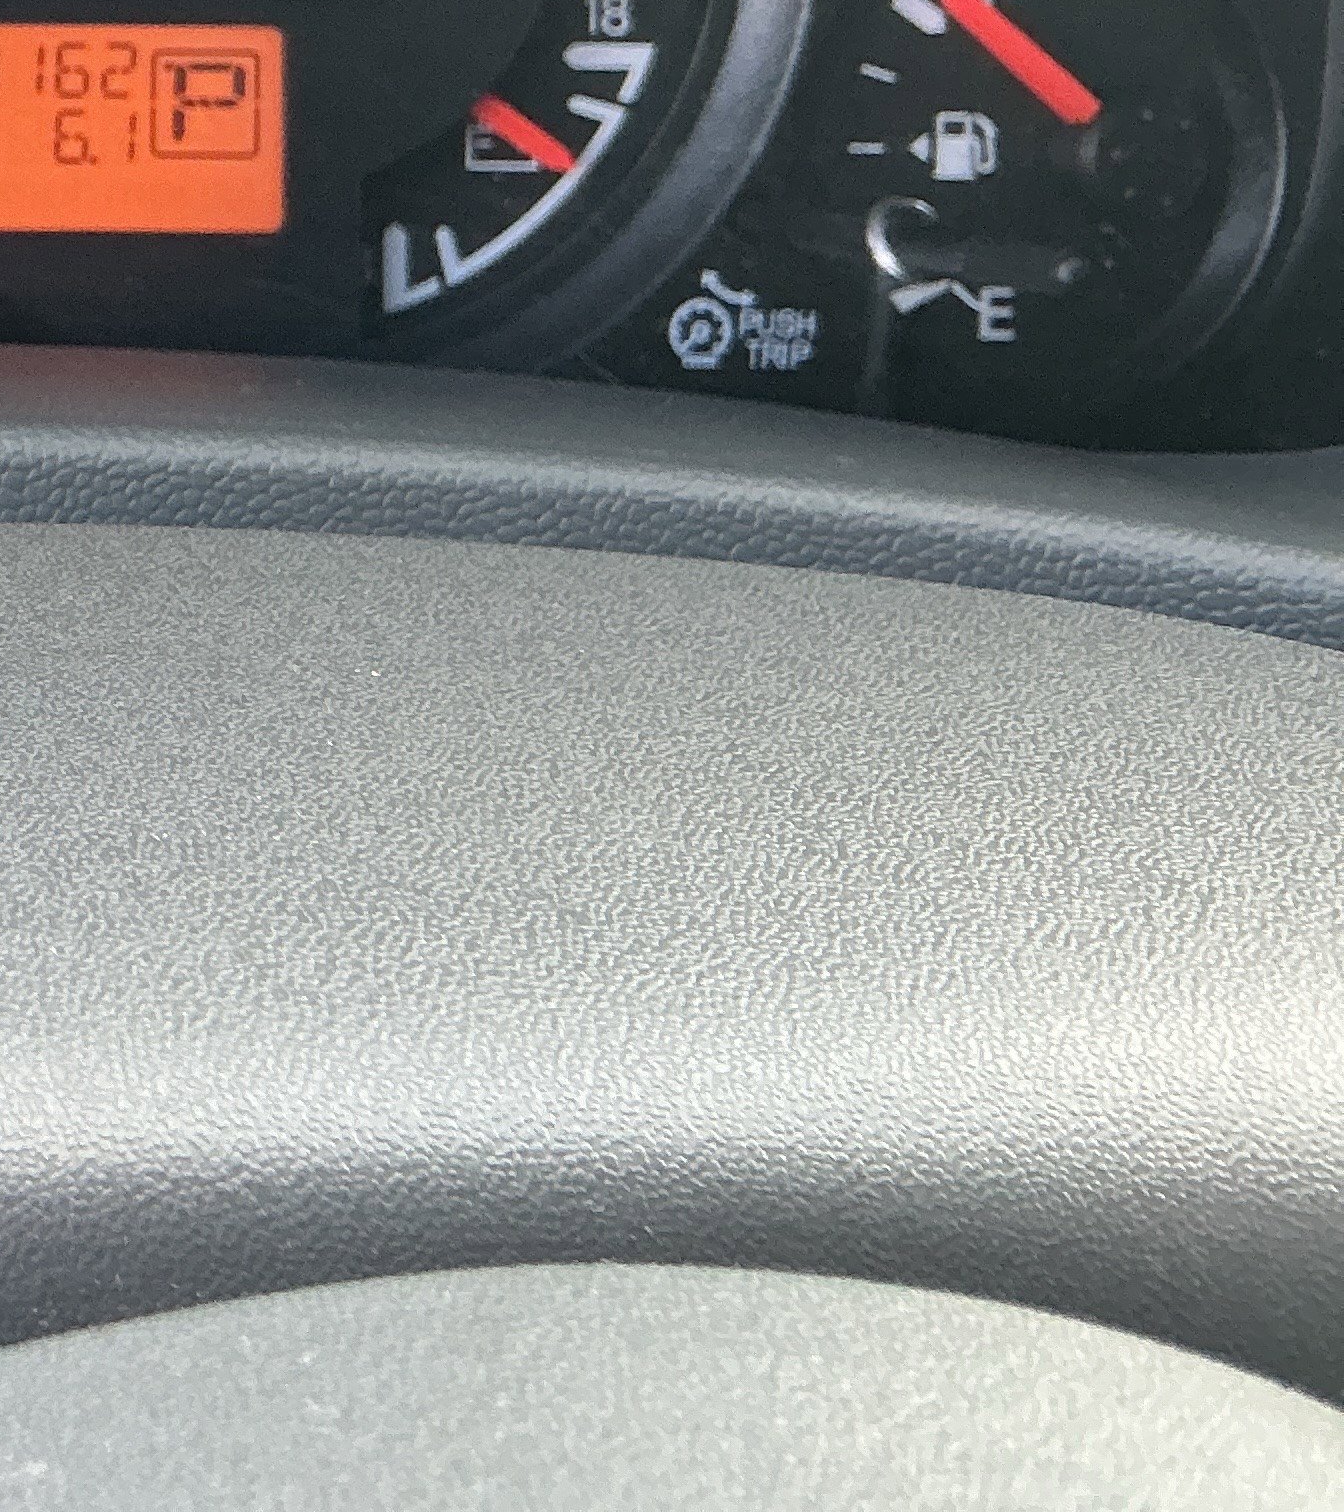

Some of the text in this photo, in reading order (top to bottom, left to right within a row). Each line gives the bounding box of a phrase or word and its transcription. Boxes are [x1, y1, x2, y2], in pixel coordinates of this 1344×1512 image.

[162, 62, 247, 142] P
[53, 107, 138, 165] 6.1
[738, 306, 818, 340] PUSH
[976, 286, 1015, 342] E
[746, 337, 813, 371] TRIP
